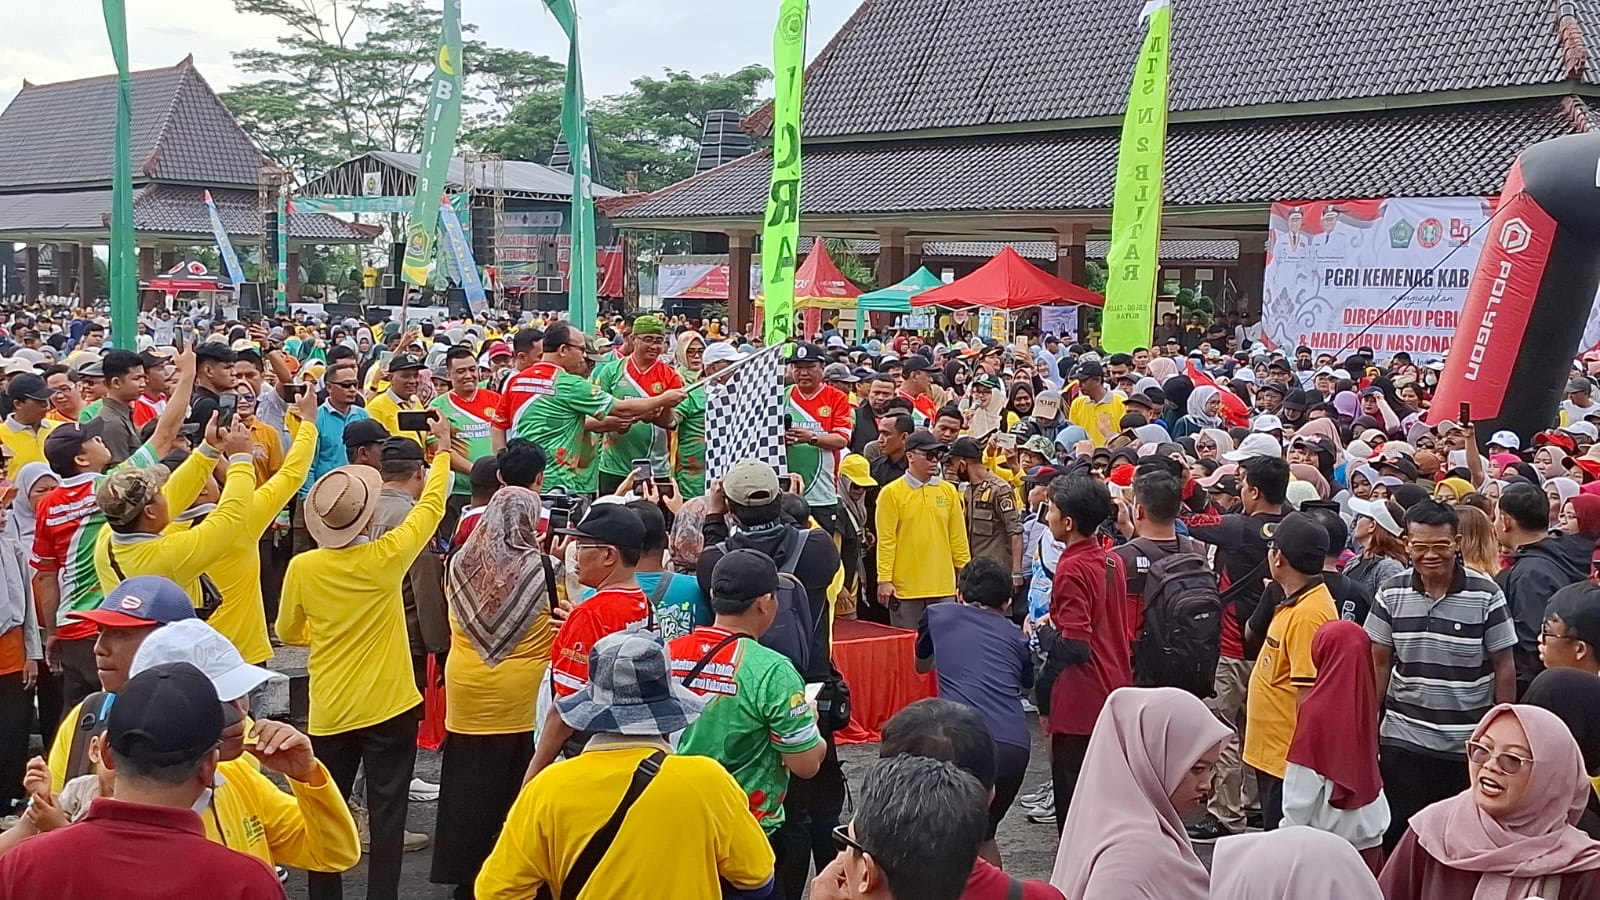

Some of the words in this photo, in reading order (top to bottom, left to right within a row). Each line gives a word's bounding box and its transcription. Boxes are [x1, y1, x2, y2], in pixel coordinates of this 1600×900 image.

[1324, 268, 1358, 287] PGRI
[1363, 268, 1433, 288] KEMENAG
[1343, 308, 1422, 327] DIRGAHAYU
[1425, 309, 1458, 328] PGRI
[1465, 260, 1511, 381] POLYGON
[1300, 334, 1306, 346] &
[1310, 332, 1343, 349] HARI
[1346, 333, 1382, 350] GURU
[1386, 334, 1453, 353] NASIONA
